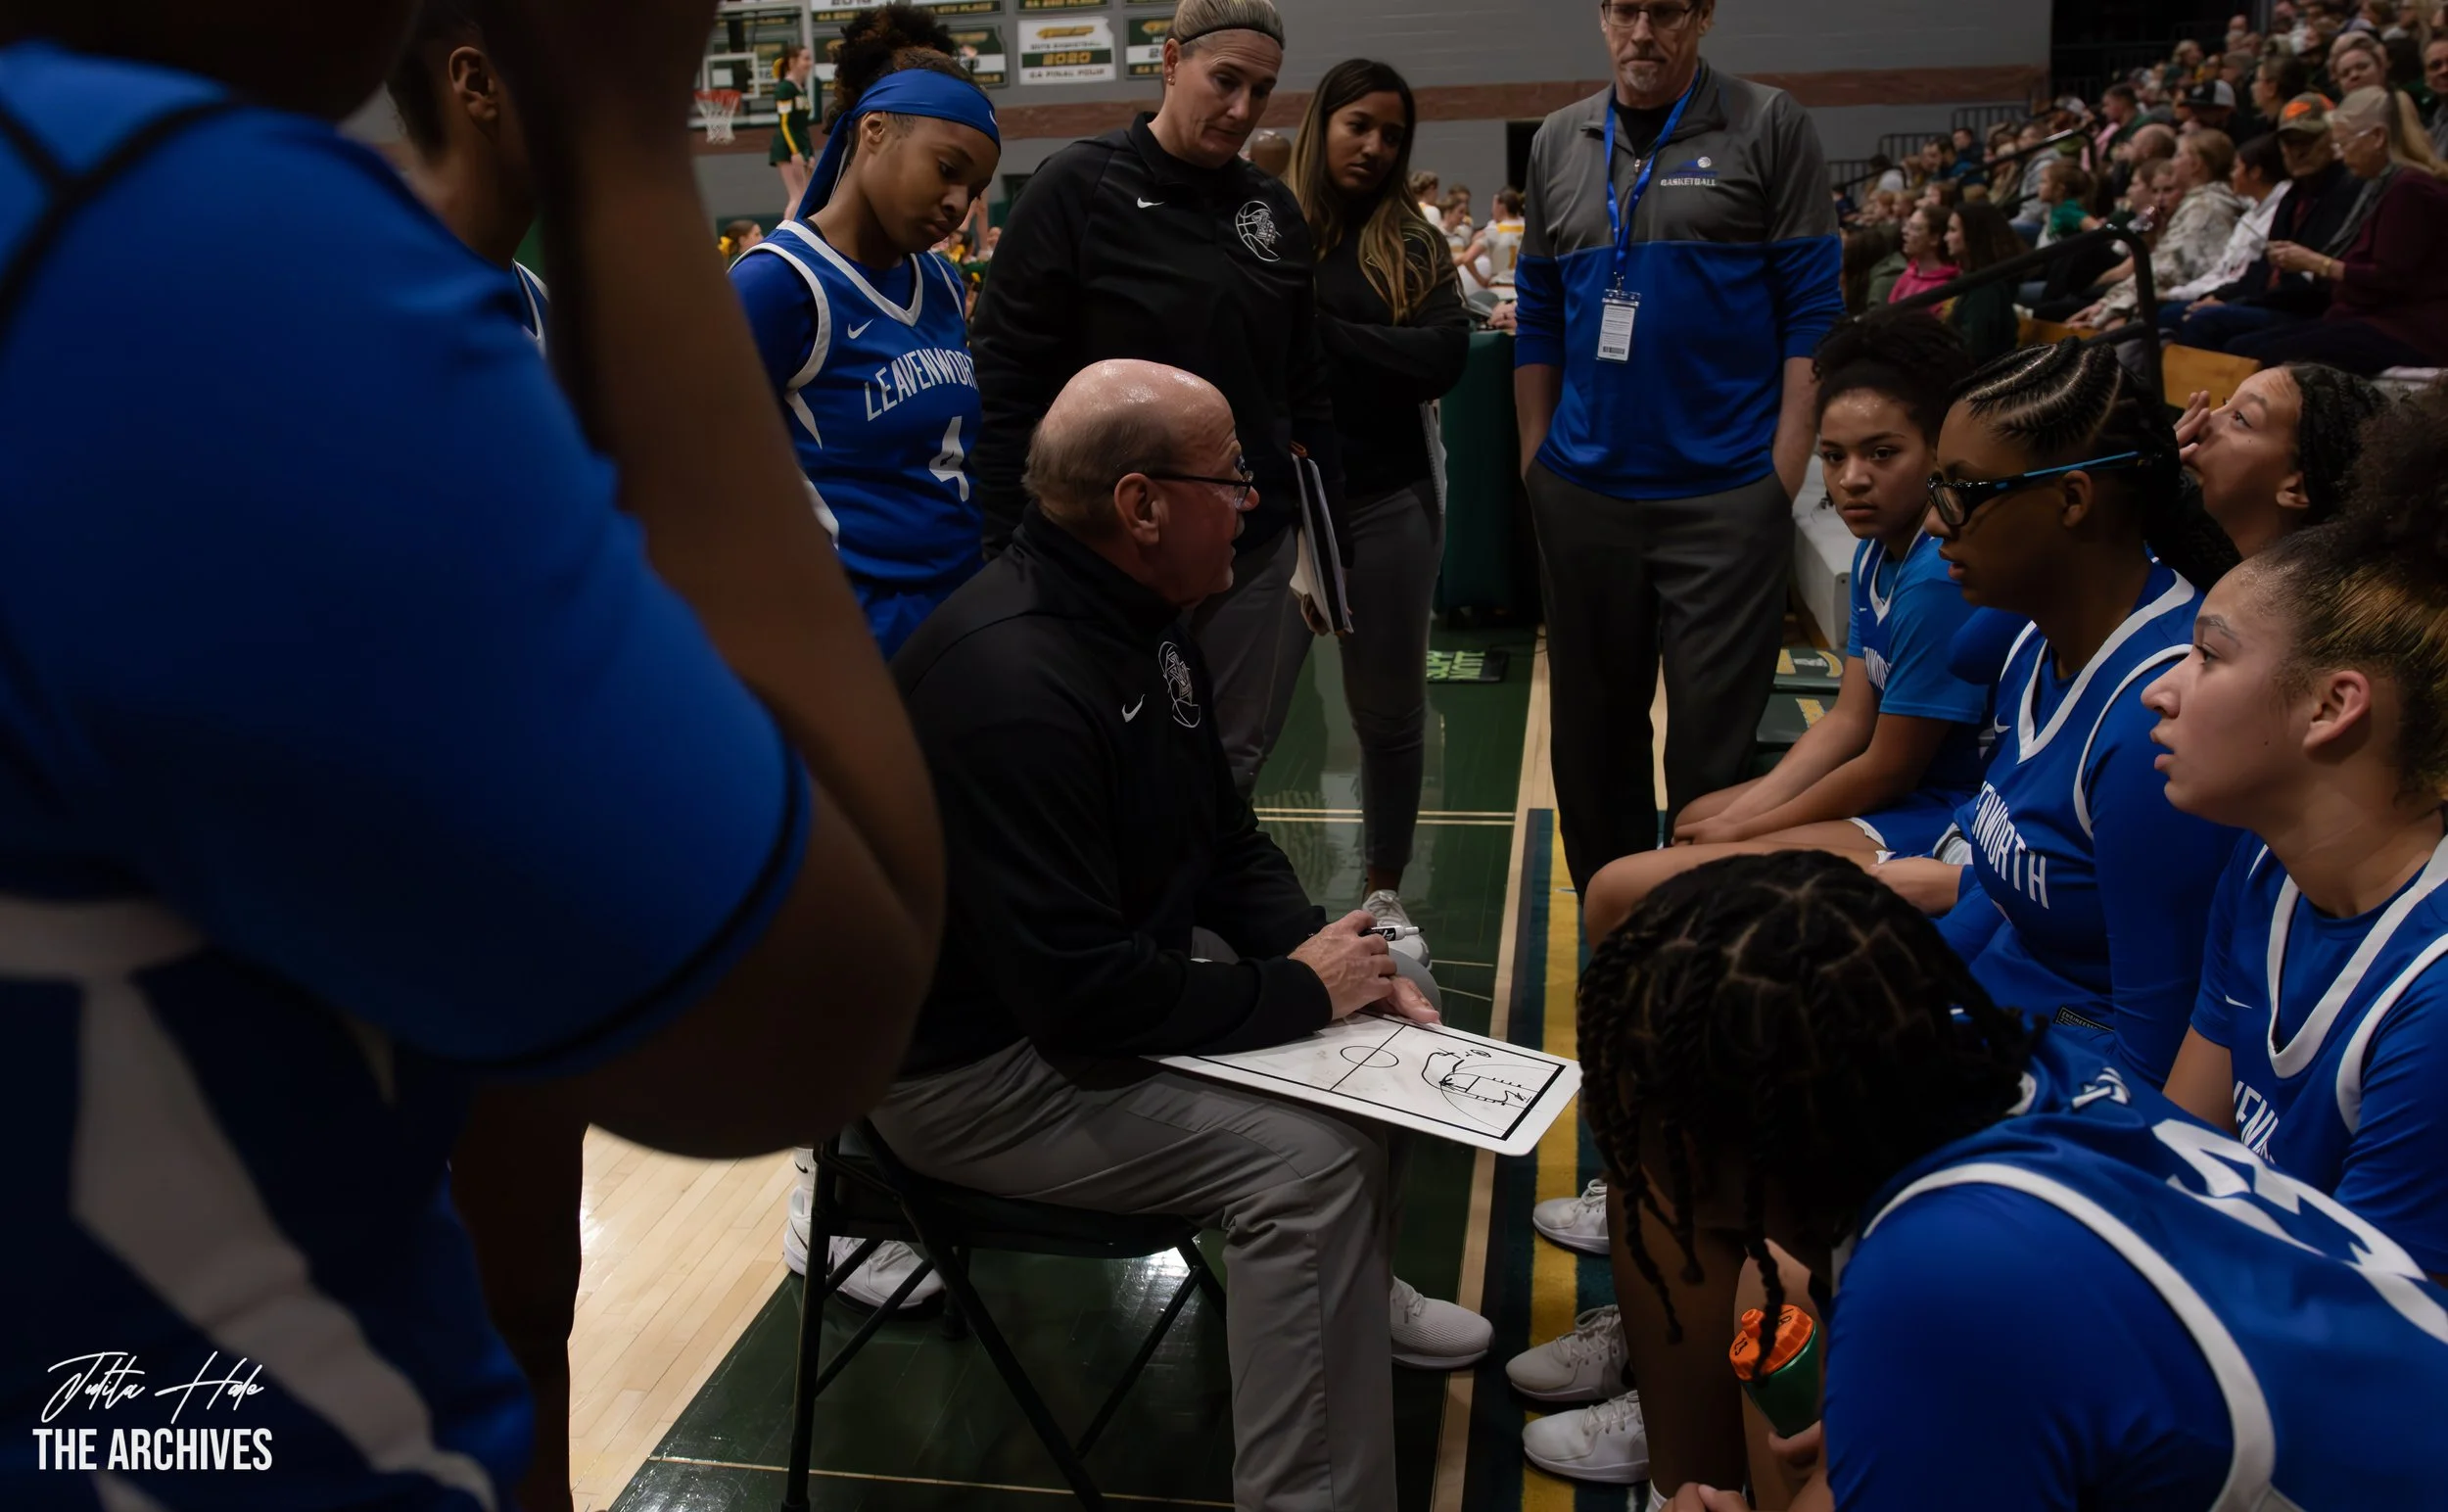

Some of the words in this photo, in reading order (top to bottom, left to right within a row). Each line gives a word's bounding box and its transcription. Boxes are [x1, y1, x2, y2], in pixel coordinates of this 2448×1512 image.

[1042, 51, 1092, 67] 2020
[1661, 177, 1717, 187] BASKETBALL
[928, 415, 970, 502] 4
